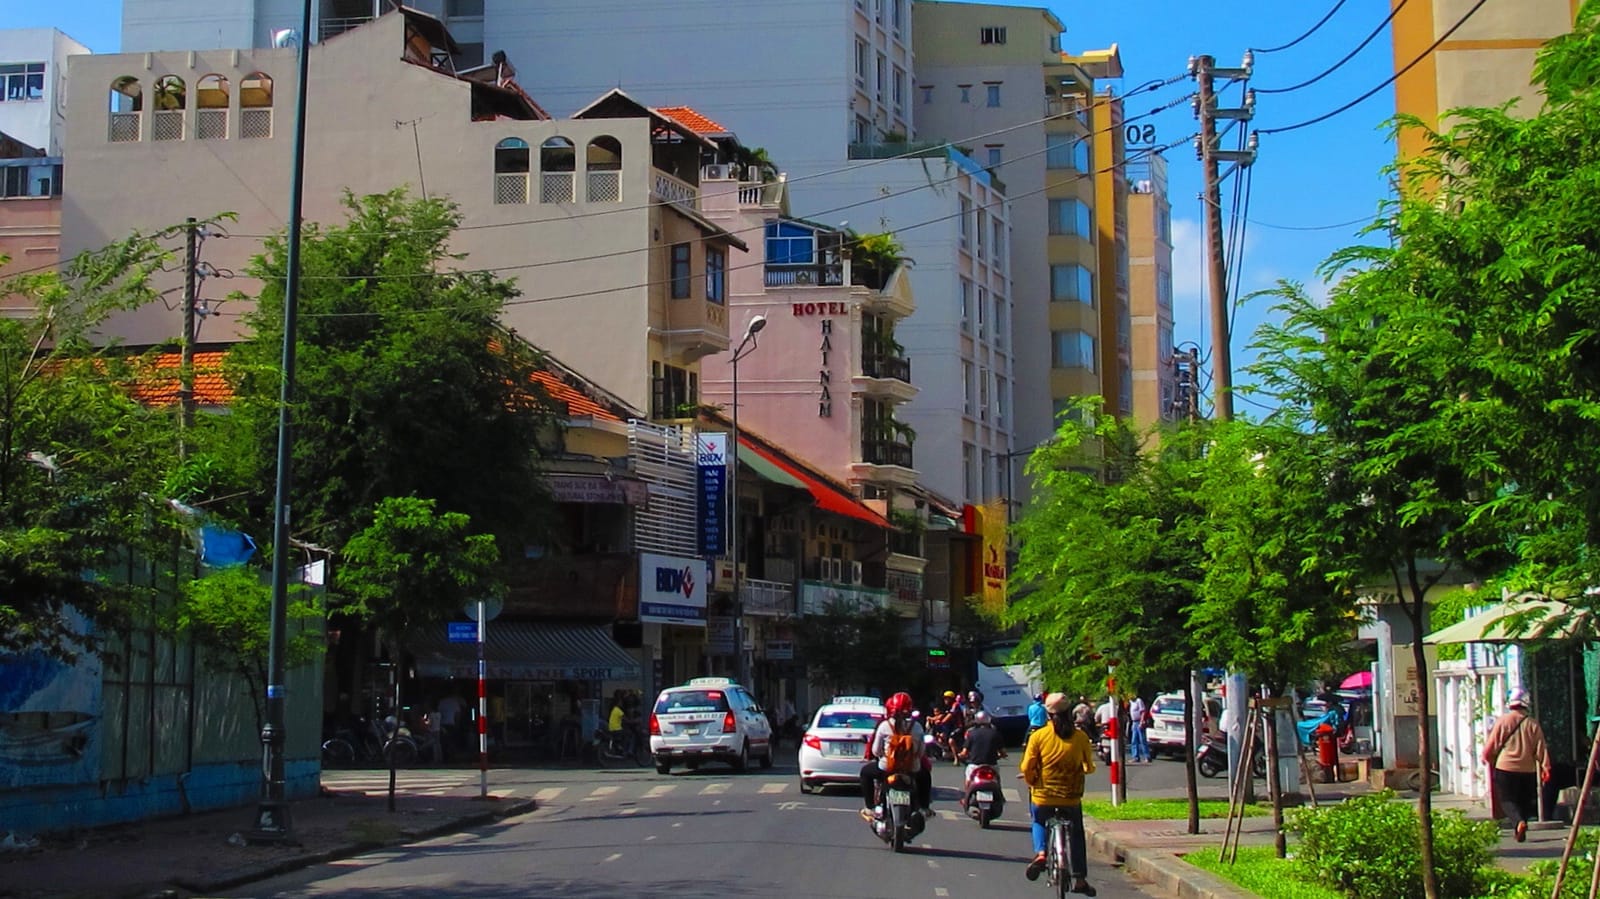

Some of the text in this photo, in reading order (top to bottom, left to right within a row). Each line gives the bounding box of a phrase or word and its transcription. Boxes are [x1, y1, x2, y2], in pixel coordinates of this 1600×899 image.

[792, 302, 849, 317] HOTEL
[698, 453, 724, 464] BIDV
[656, 566, 683, 594] BIDV
[573, 667, 612, 679] SPORT
